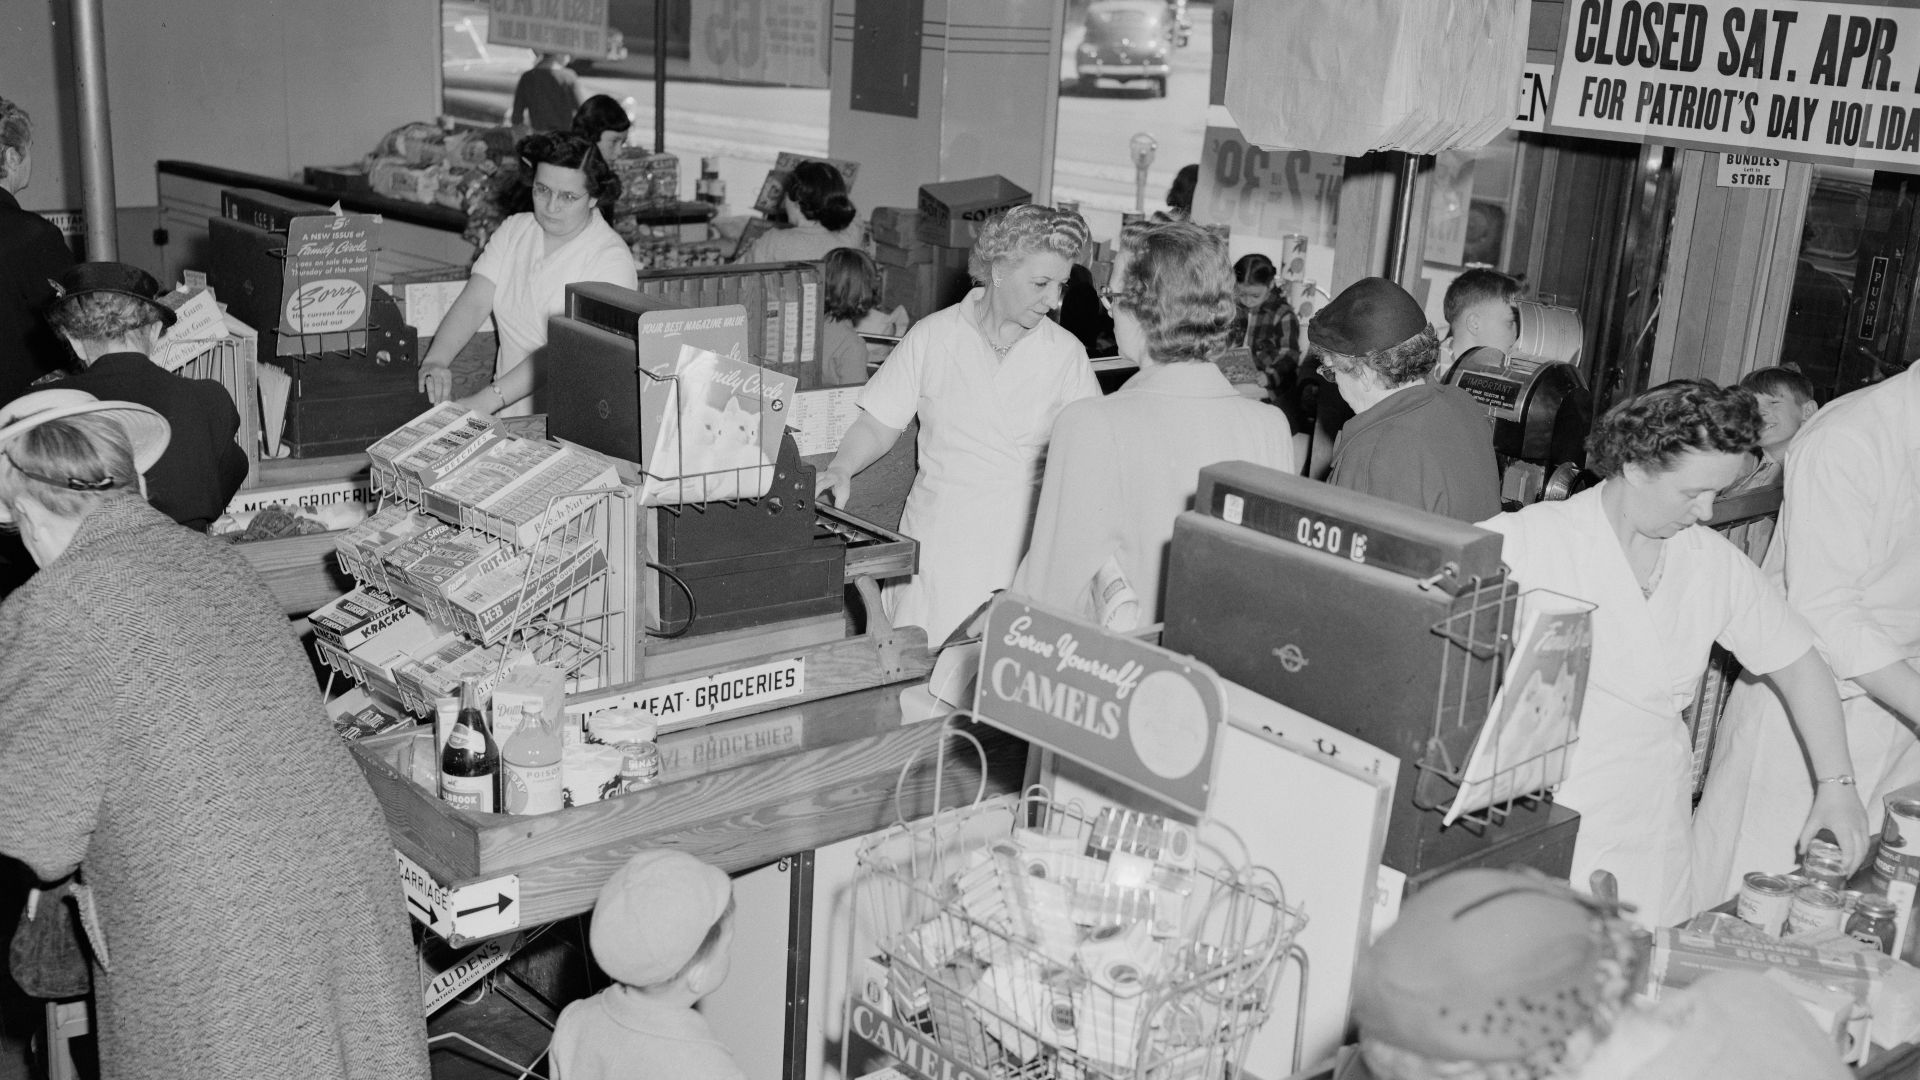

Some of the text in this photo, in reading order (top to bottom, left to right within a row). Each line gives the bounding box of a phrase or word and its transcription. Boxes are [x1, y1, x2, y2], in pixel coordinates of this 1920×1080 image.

[1574, 0, 1901, 93] CLOSED SAT. APR.
[1578, 76, 1920, 153] FOR PATRIOT'S DAY HOLIDA
[1726, 153, 1780, 167] BUNDLES
[1731, 173, 1772, 187] STORE
[302, 230, 366, 241] A NEW ISSUE of
[297, 239, 368, 258] Family Circle
[342, 257, 354, 265] the
[355, 256, 368, 264] last
[291, 267, 323, 277] Thursday
[334, 264, 347, 273] this
[292, 285, 361, 312] Sorry
[1864, 271, 1882, 325] PUSH
[183, 303, 204, 318] Gum
[192, 316, 211, 329] Gum
[307, 309, 335, 319] current
[336, 308, 356, 317] issue
[311, 320, 329, 328] sold
[330, 318, 343, 327] out
[642, 315, 746, 335] YOUR BEST MAGAZINE VALUE
[742, 372, 784, 398] Circle
[1467, 377, 1513, 394] IMPORTANT
[298, 485, 378, 508] GROCERIE
[1296, 517, 1341, 554] 0.30
[361, 605, 411, 639] KRACKEL
[481, 604, 504, 626] H-B
[1003, 615, 1144, 699] Serve Yourself
[695, 667, 796, 708] GROCERIES
[991, 657, 1122, 739] CAMELS
[398, 858, 448, 911] CARRIAGE
[433, 940, 501, 994] LUDEN'S
[426, 951, 504, 1010] MENTHOL COUGH DROPS
[853, 1005, 974, 1080] CAMEL
